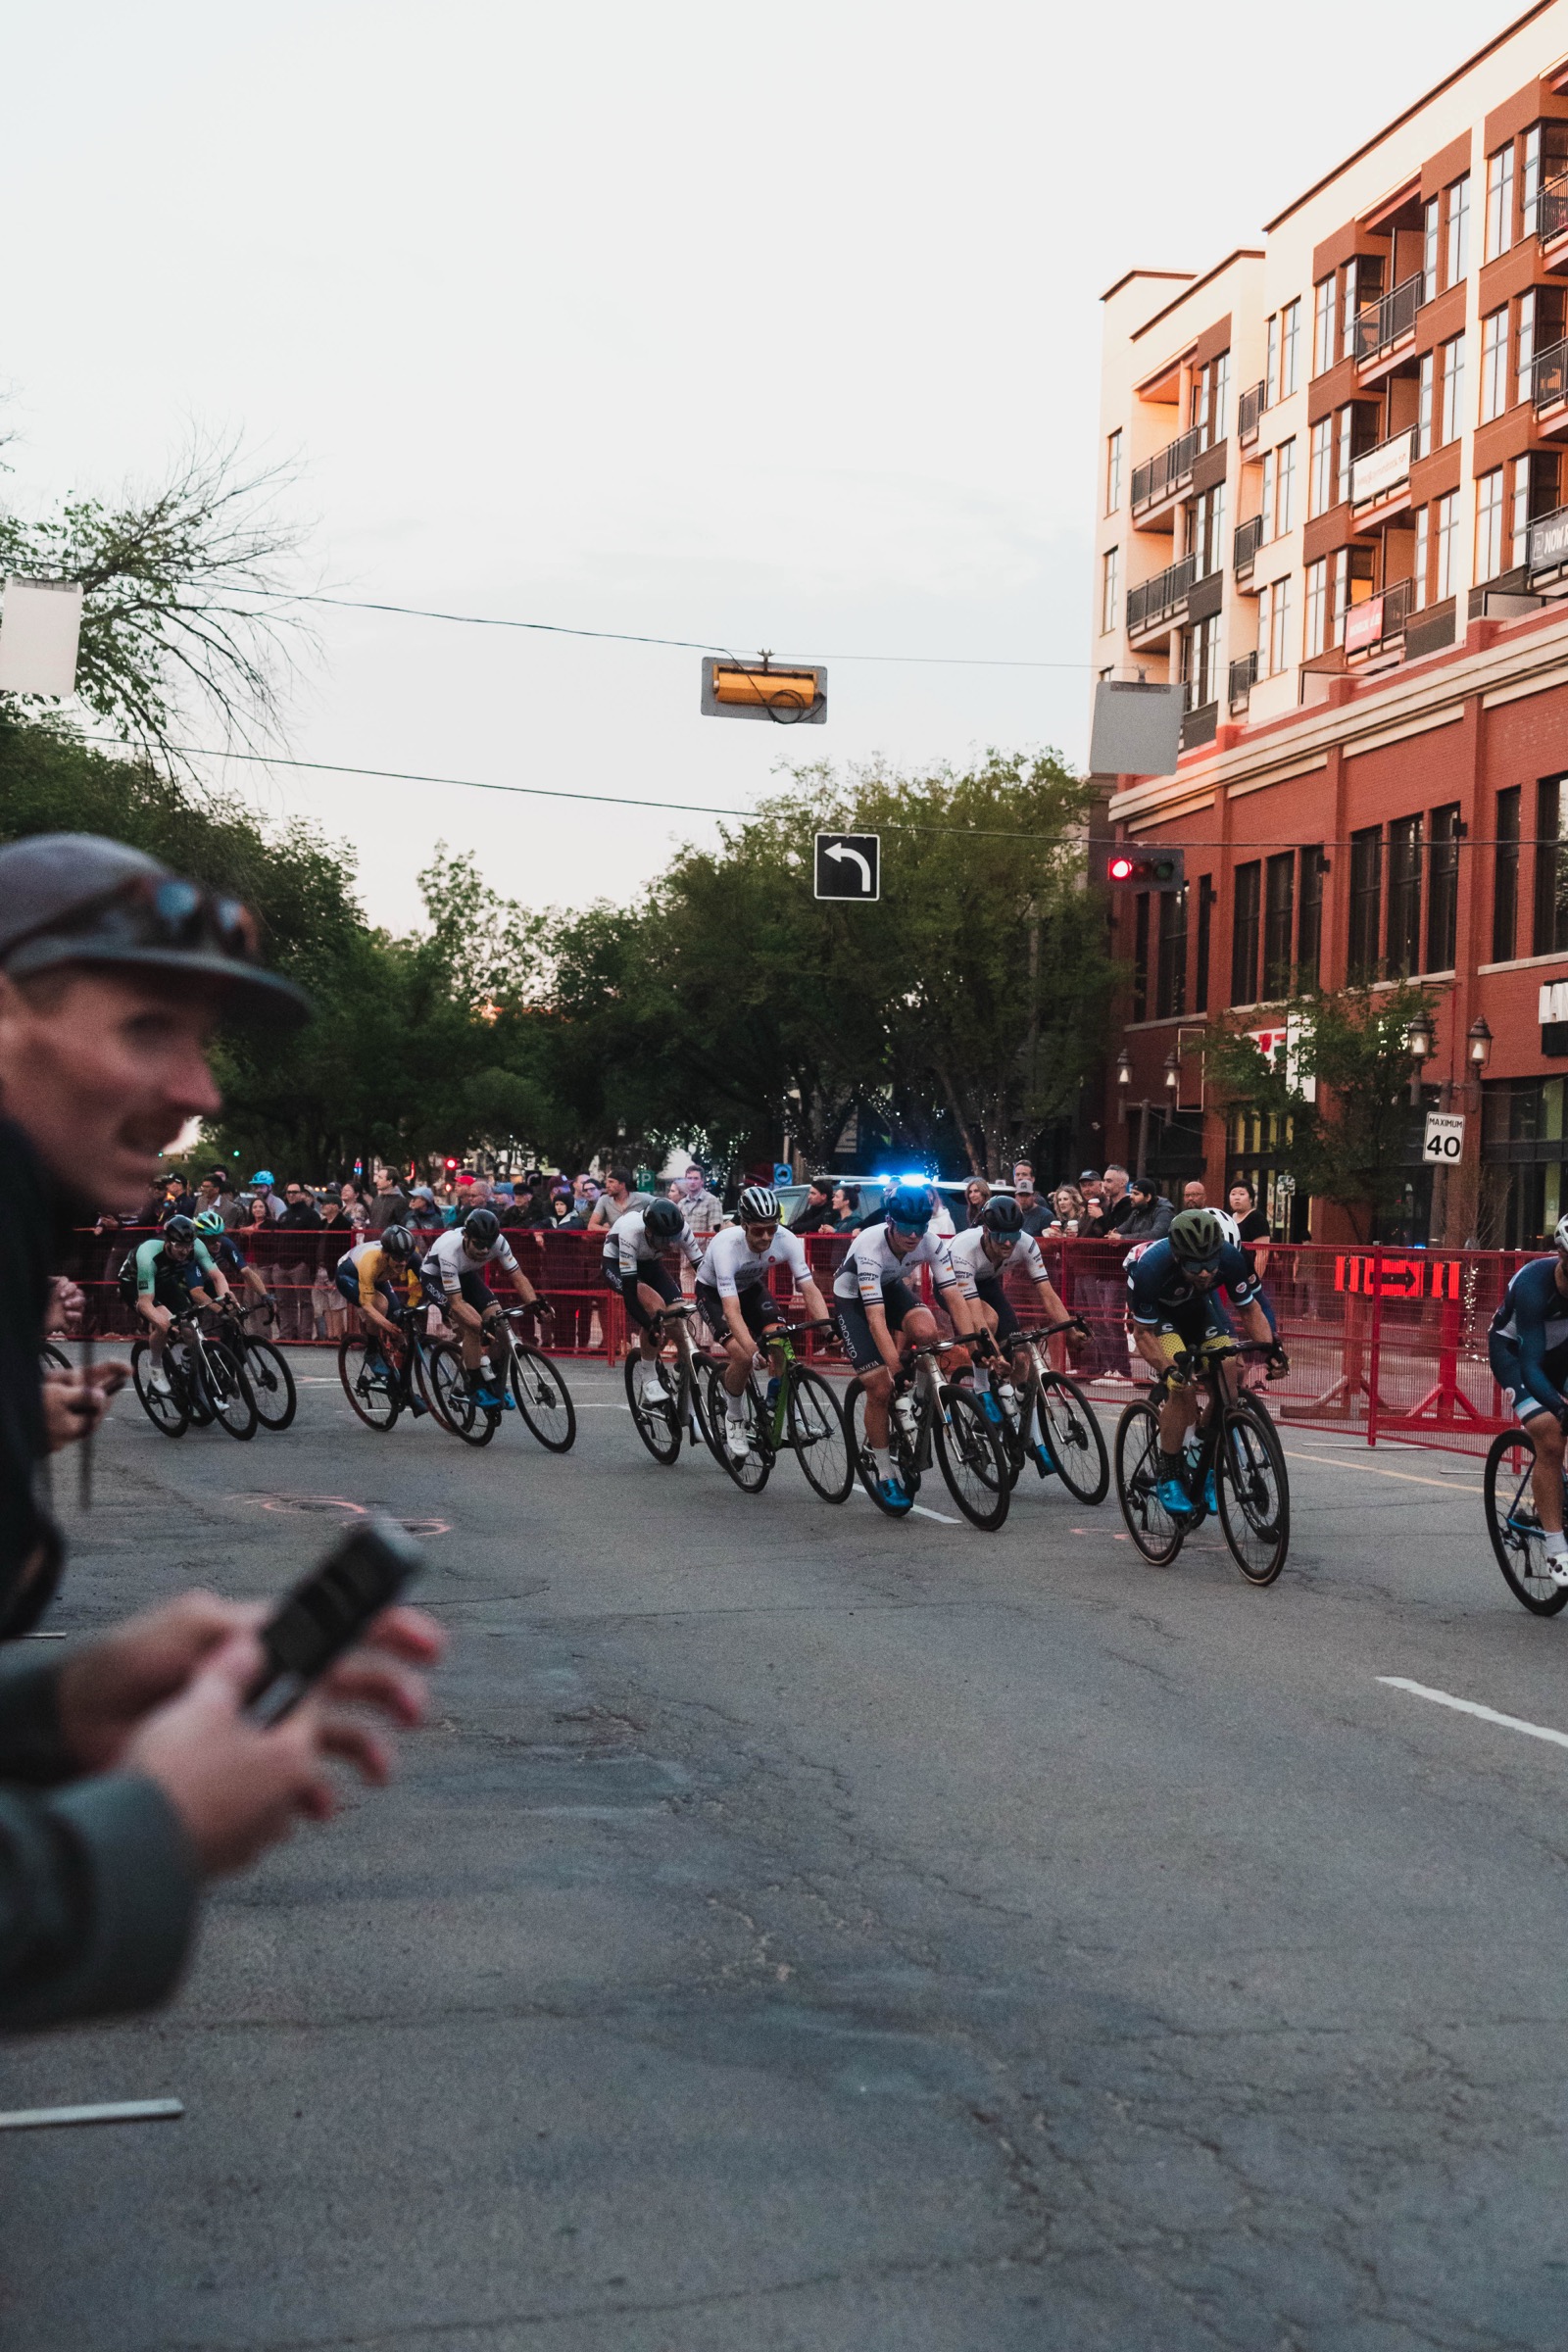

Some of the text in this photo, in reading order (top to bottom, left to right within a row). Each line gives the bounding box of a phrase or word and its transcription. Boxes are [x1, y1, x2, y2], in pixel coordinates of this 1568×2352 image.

[1544, 525, 1564, 555] NOW
[1429, 1117, 1463, 1128] MAXIMUM
[1427, 1134, 1461, 1157] 40
[641, 1172, 652, 1187] P
[837, 1314, 858, 1359] TORONTO
